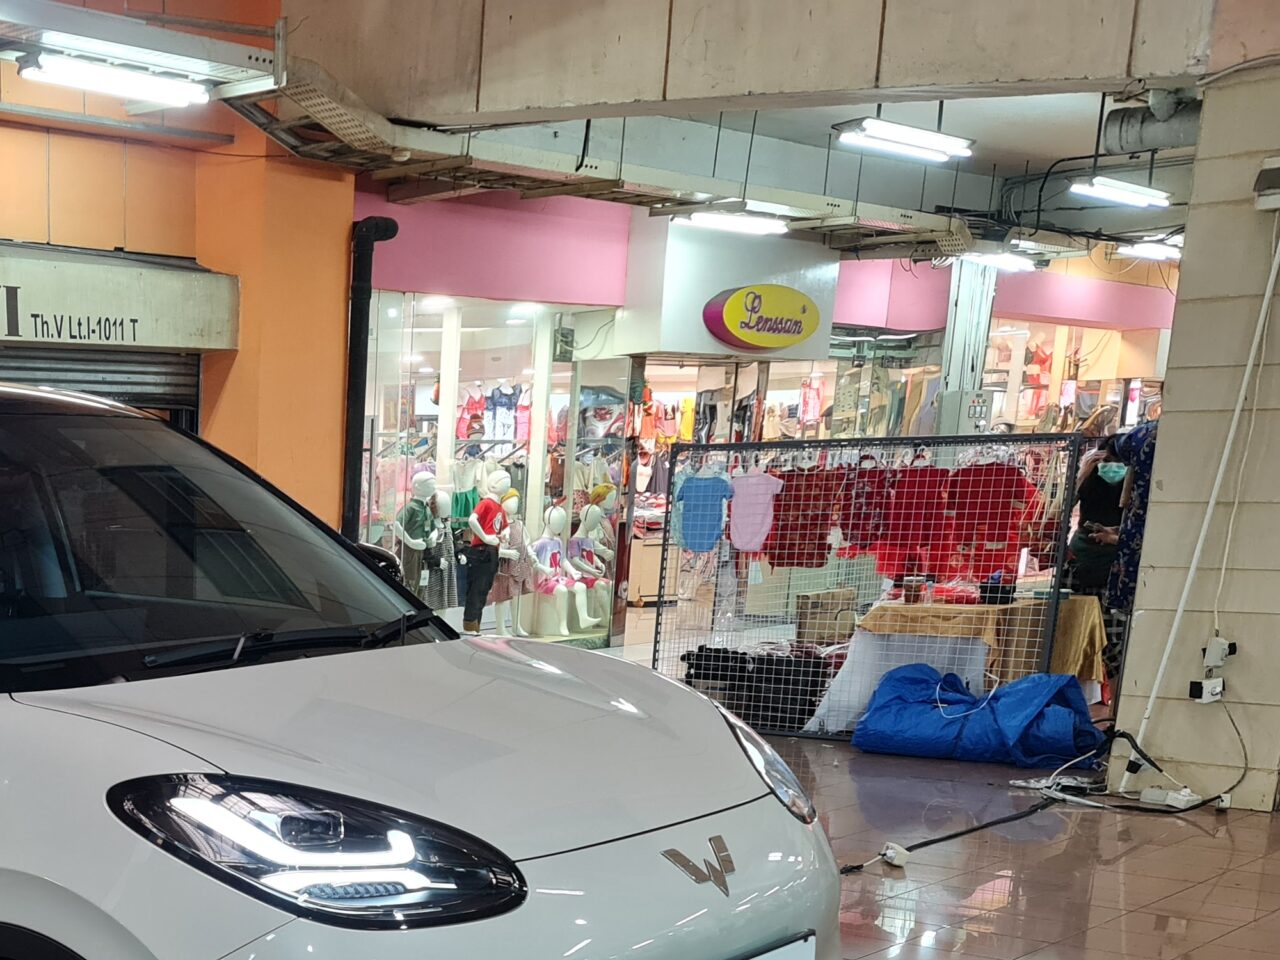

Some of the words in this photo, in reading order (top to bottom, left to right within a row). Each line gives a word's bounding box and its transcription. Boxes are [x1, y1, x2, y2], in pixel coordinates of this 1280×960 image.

[30, 313, 64, 339] Th.V
[129, 318, 139, 342] T
[739, 291, 804, 335] Lenssan
